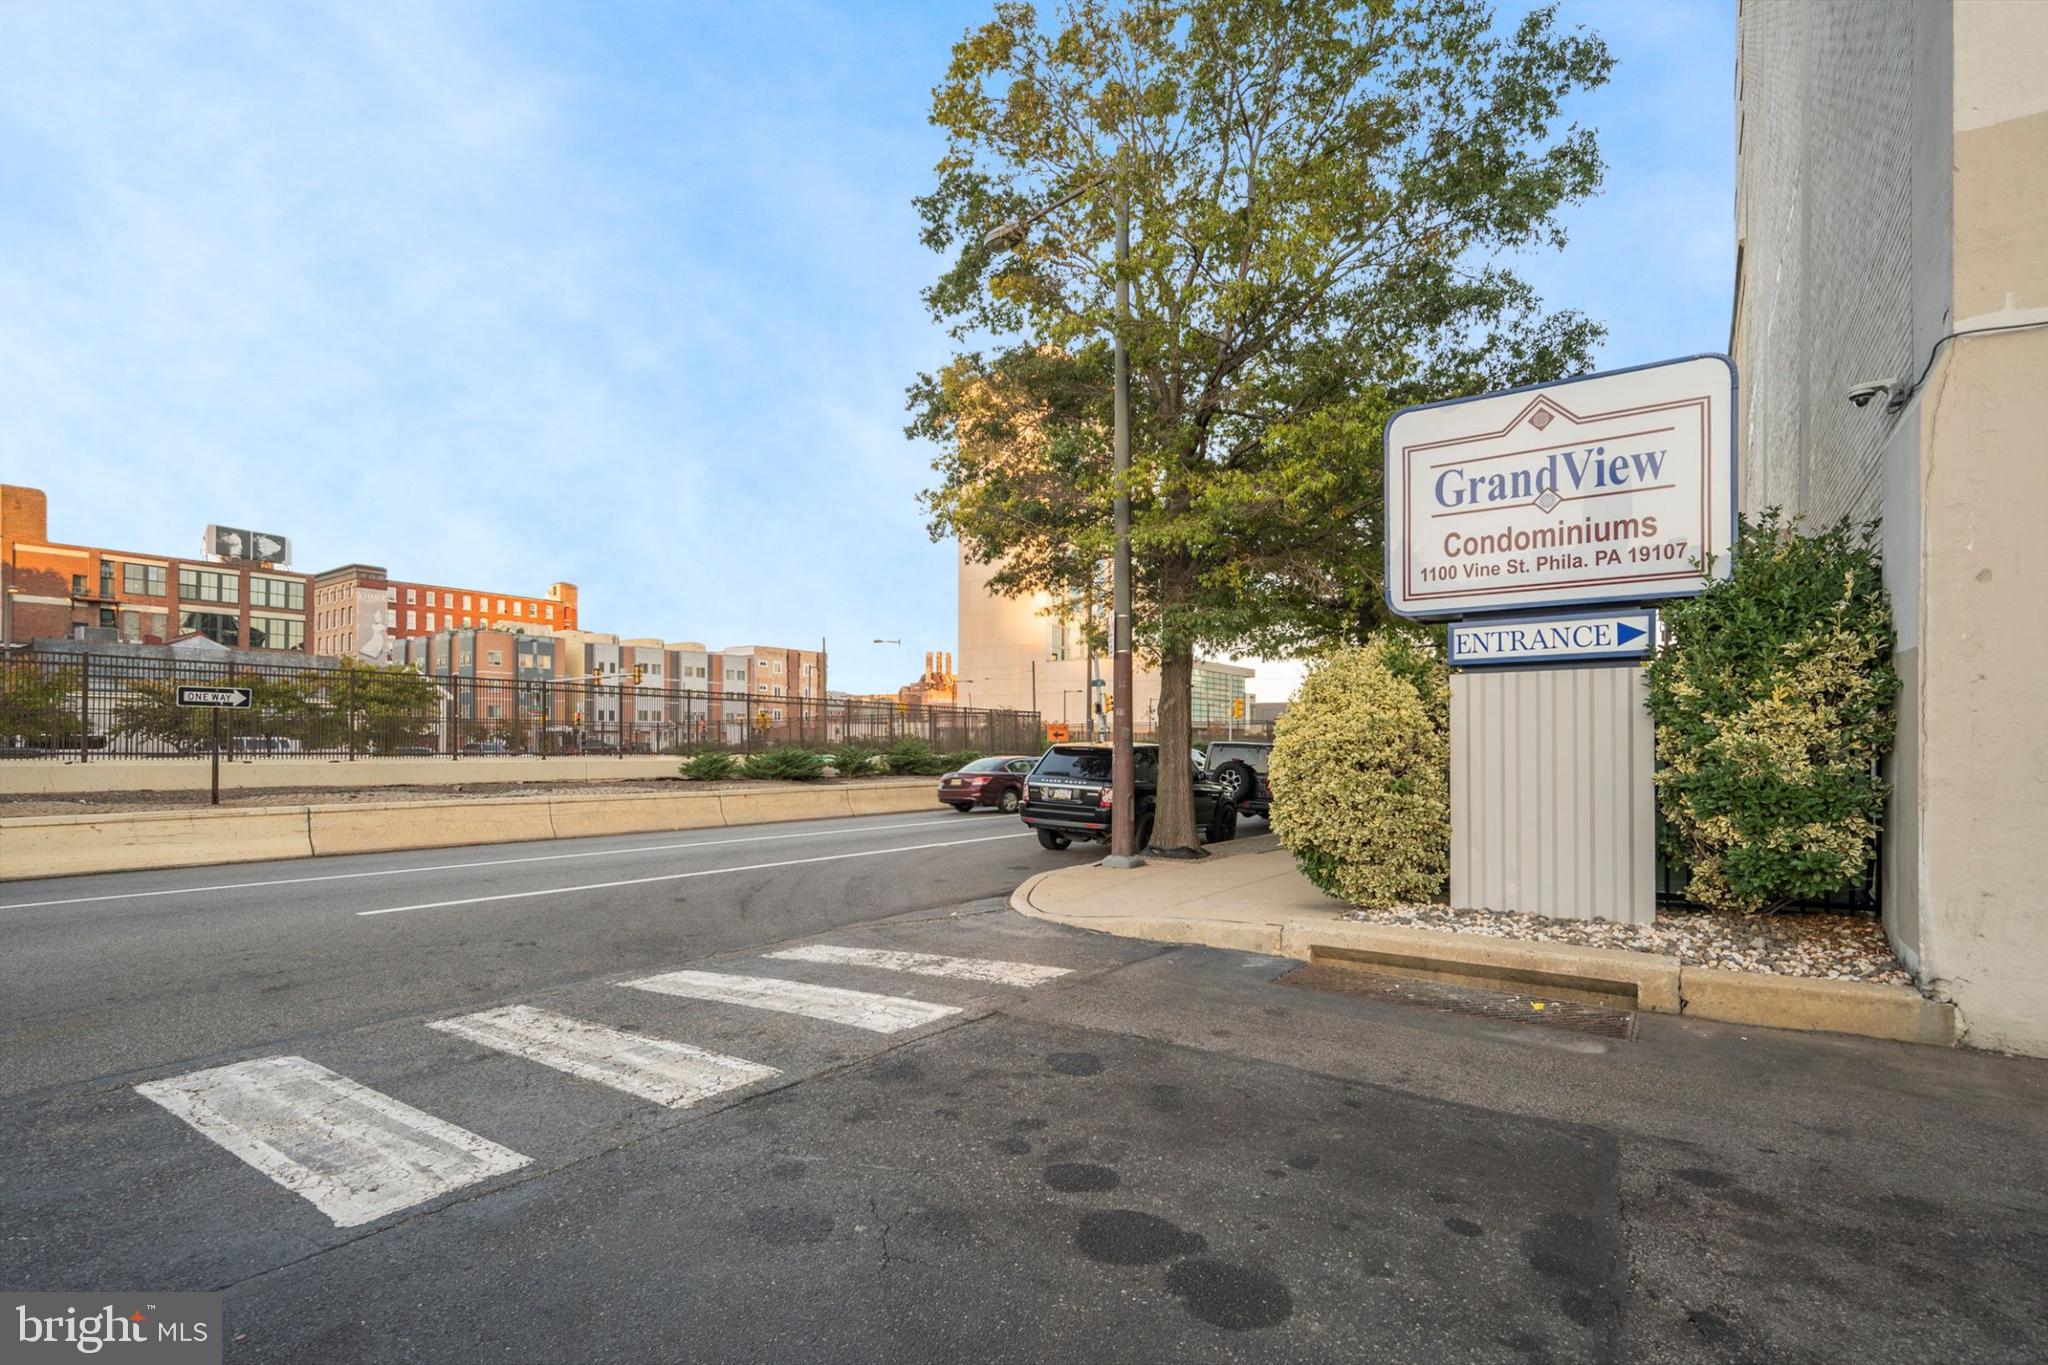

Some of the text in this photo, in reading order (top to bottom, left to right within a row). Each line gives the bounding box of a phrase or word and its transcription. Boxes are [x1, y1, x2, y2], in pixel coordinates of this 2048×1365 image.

[1444, 516, 1658, 558] Condominiums
[1420, 542, 1688, 582] 1100 Vine St. Phila. PA 19107
[1455, 623, 1612, 655] ENTRANCE
[187, 692, 231, 702] ONE WAY
